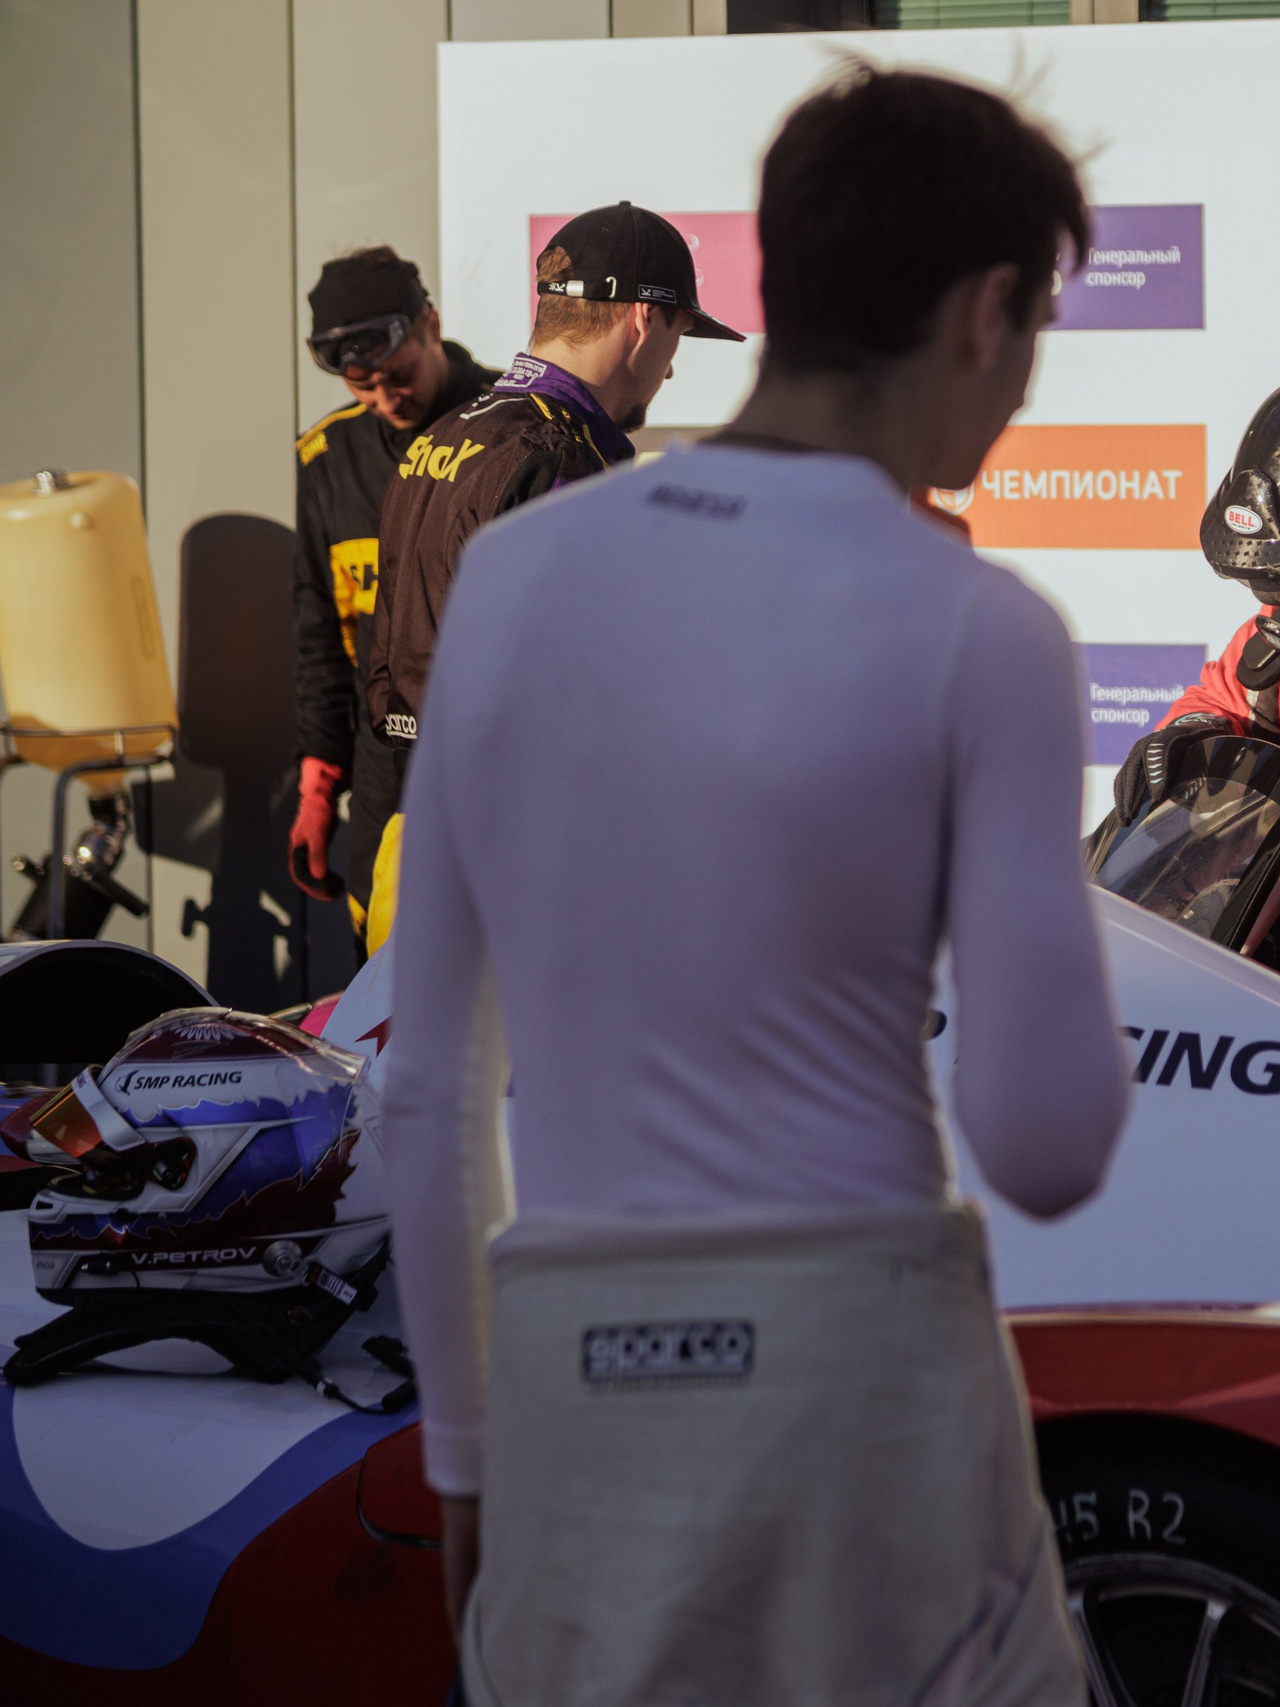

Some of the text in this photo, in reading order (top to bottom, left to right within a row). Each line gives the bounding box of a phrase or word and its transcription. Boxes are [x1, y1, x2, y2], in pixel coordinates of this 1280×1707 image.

[1088, 246, 1181, 268] Генеральный
[1087, 271, 1146, 290] спонсор
[982, 470, 1183, 500] ЧЕМПИОНАТ
[1229, 510, 1255, 528] BELL
[1089, 682, 1185, 705] Генеральный
[1091, 707, 1150, 727] спонсор
[134, 1071, 242, 1090] SMP RACING
